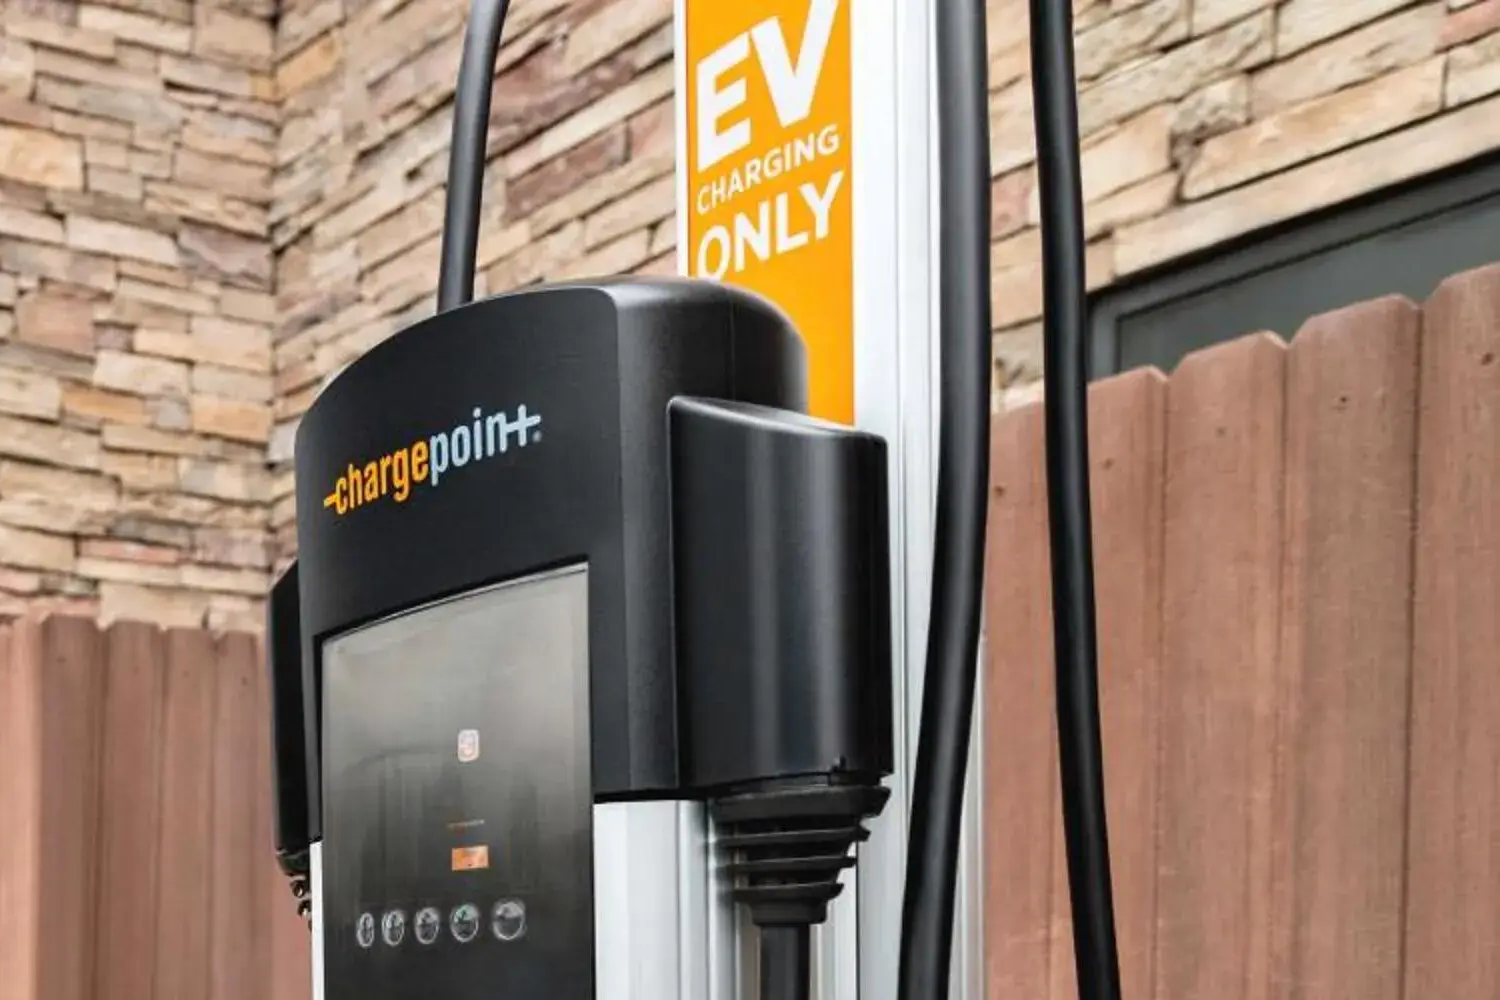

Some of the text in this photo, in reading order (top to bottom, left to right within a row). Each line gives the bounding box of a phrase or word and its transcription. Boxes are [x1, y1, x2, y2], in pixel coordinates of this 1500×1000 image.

[697, 0, 839, 173] EV
[696, 124, 841, 215] CHARGING
[697, 170, 844, 282] ONLY
